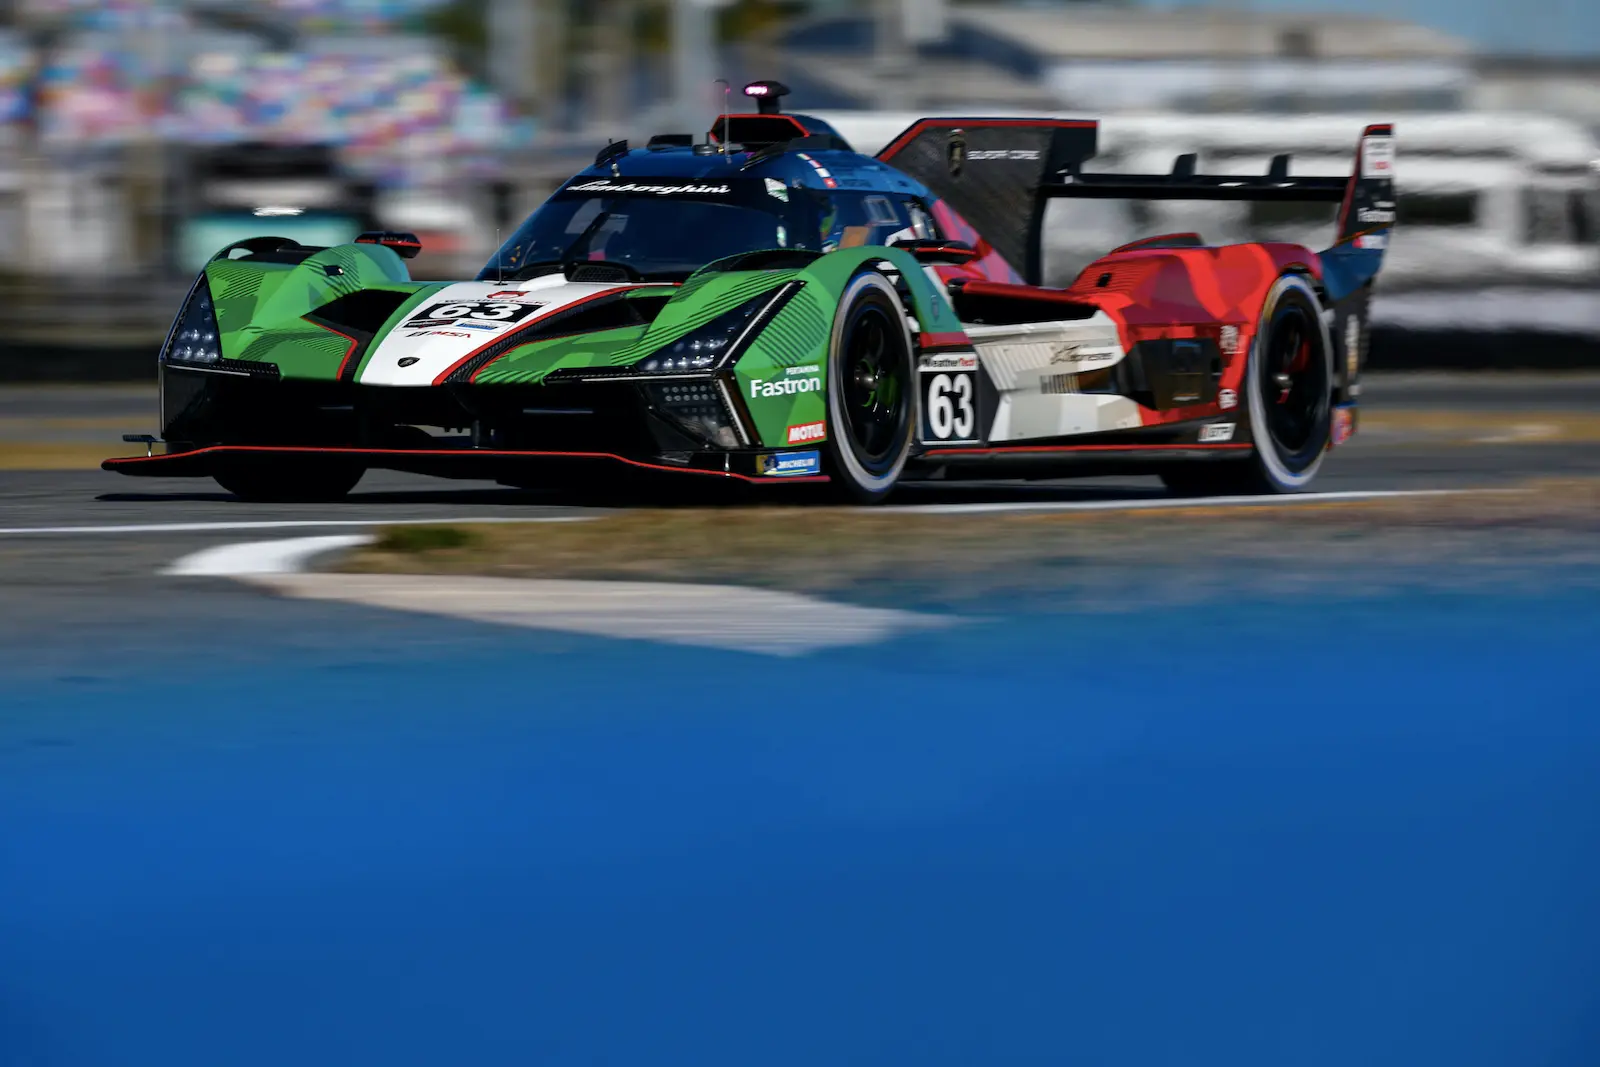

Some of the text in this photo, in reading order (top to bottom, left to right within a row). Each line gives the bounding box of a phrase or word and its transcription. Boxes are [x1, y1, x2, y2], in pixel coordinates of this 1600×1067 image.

[566, 180, 731, 195] Lamborghini
[428, 303, 522, 320] 63
[751, 378, 820, 398] Fastron
[928, 373, 975, 439] 63
[788, 423, 825, 442] MOTUL
